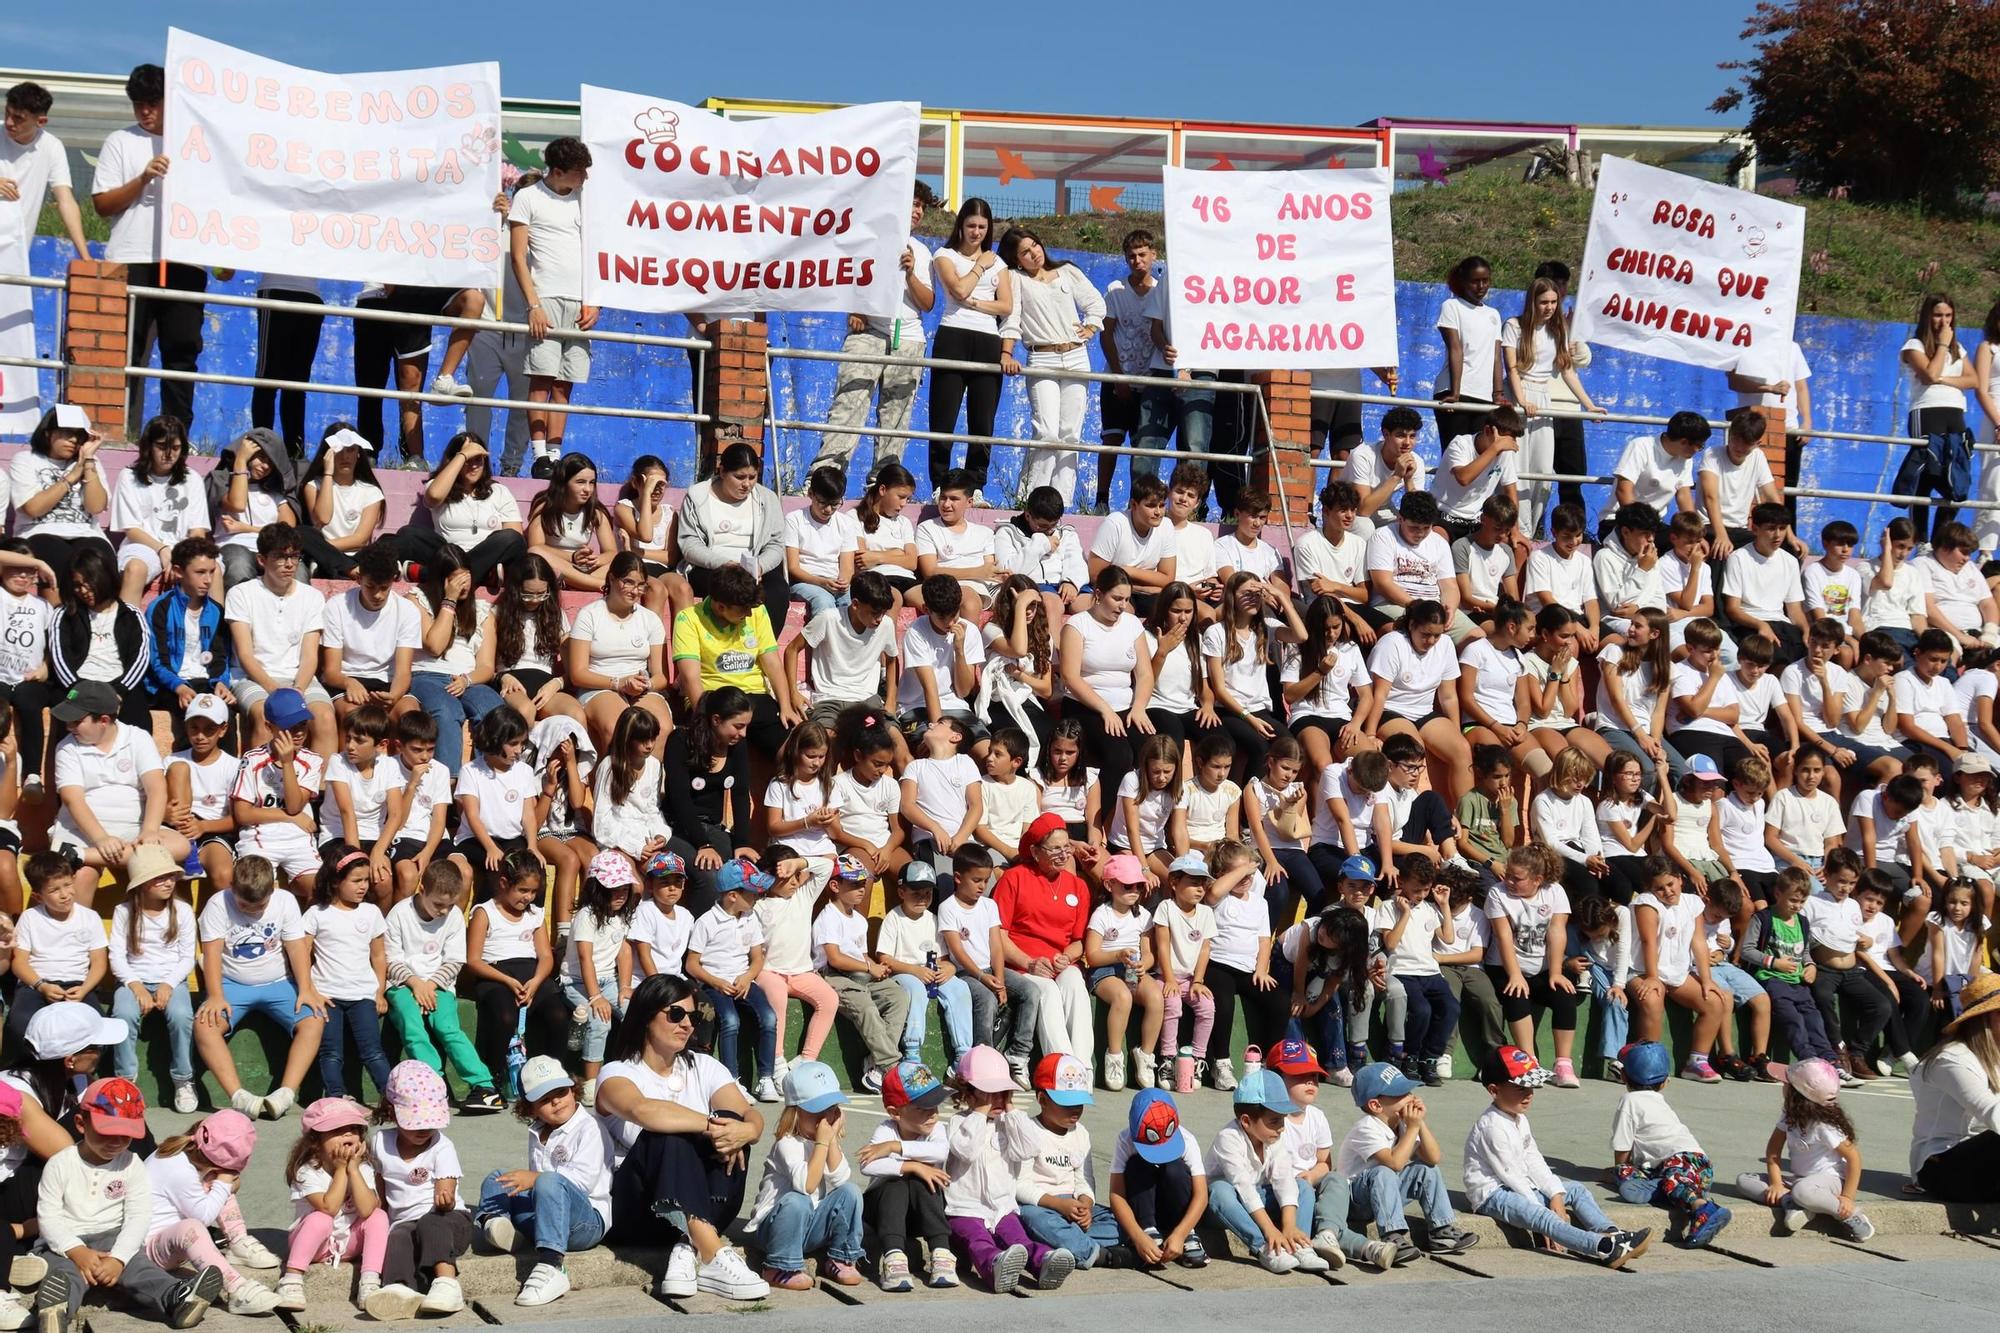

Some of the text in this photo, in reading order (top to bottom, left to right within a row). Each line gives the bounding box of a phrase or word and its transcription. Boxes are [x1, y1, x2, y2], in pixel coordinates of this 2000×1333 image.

[182, 58, 477, 125] QUEREMOS
[182, 124, 212, 163] A
[624, 138, 881, 179] COCIÑANDO
[627, 199, 853, 236] MOMENTOS
[1191, 192, 1373, 223] 46 ANOS
[1652, 199, 1716, 239] ROSA
[169, 203, 500, 262] DAS POTAXES
[1256, 233, 1296, 261] DE
[598, 251, 875, 294] INESQUECIBLES
[1183, 273, 1356, 305] SABOR E
[1607, 247, 1769, 301] CHEIRA QUE
[1200, 321, 1365, 352] AGARIMO
[1602, 292, 1753, 347] ALIMENTA
[5, 627, 35, 648] GO
[722, 661, 750, 671] Galicia
[1045, 1154, 1072, 1168] WALLR
